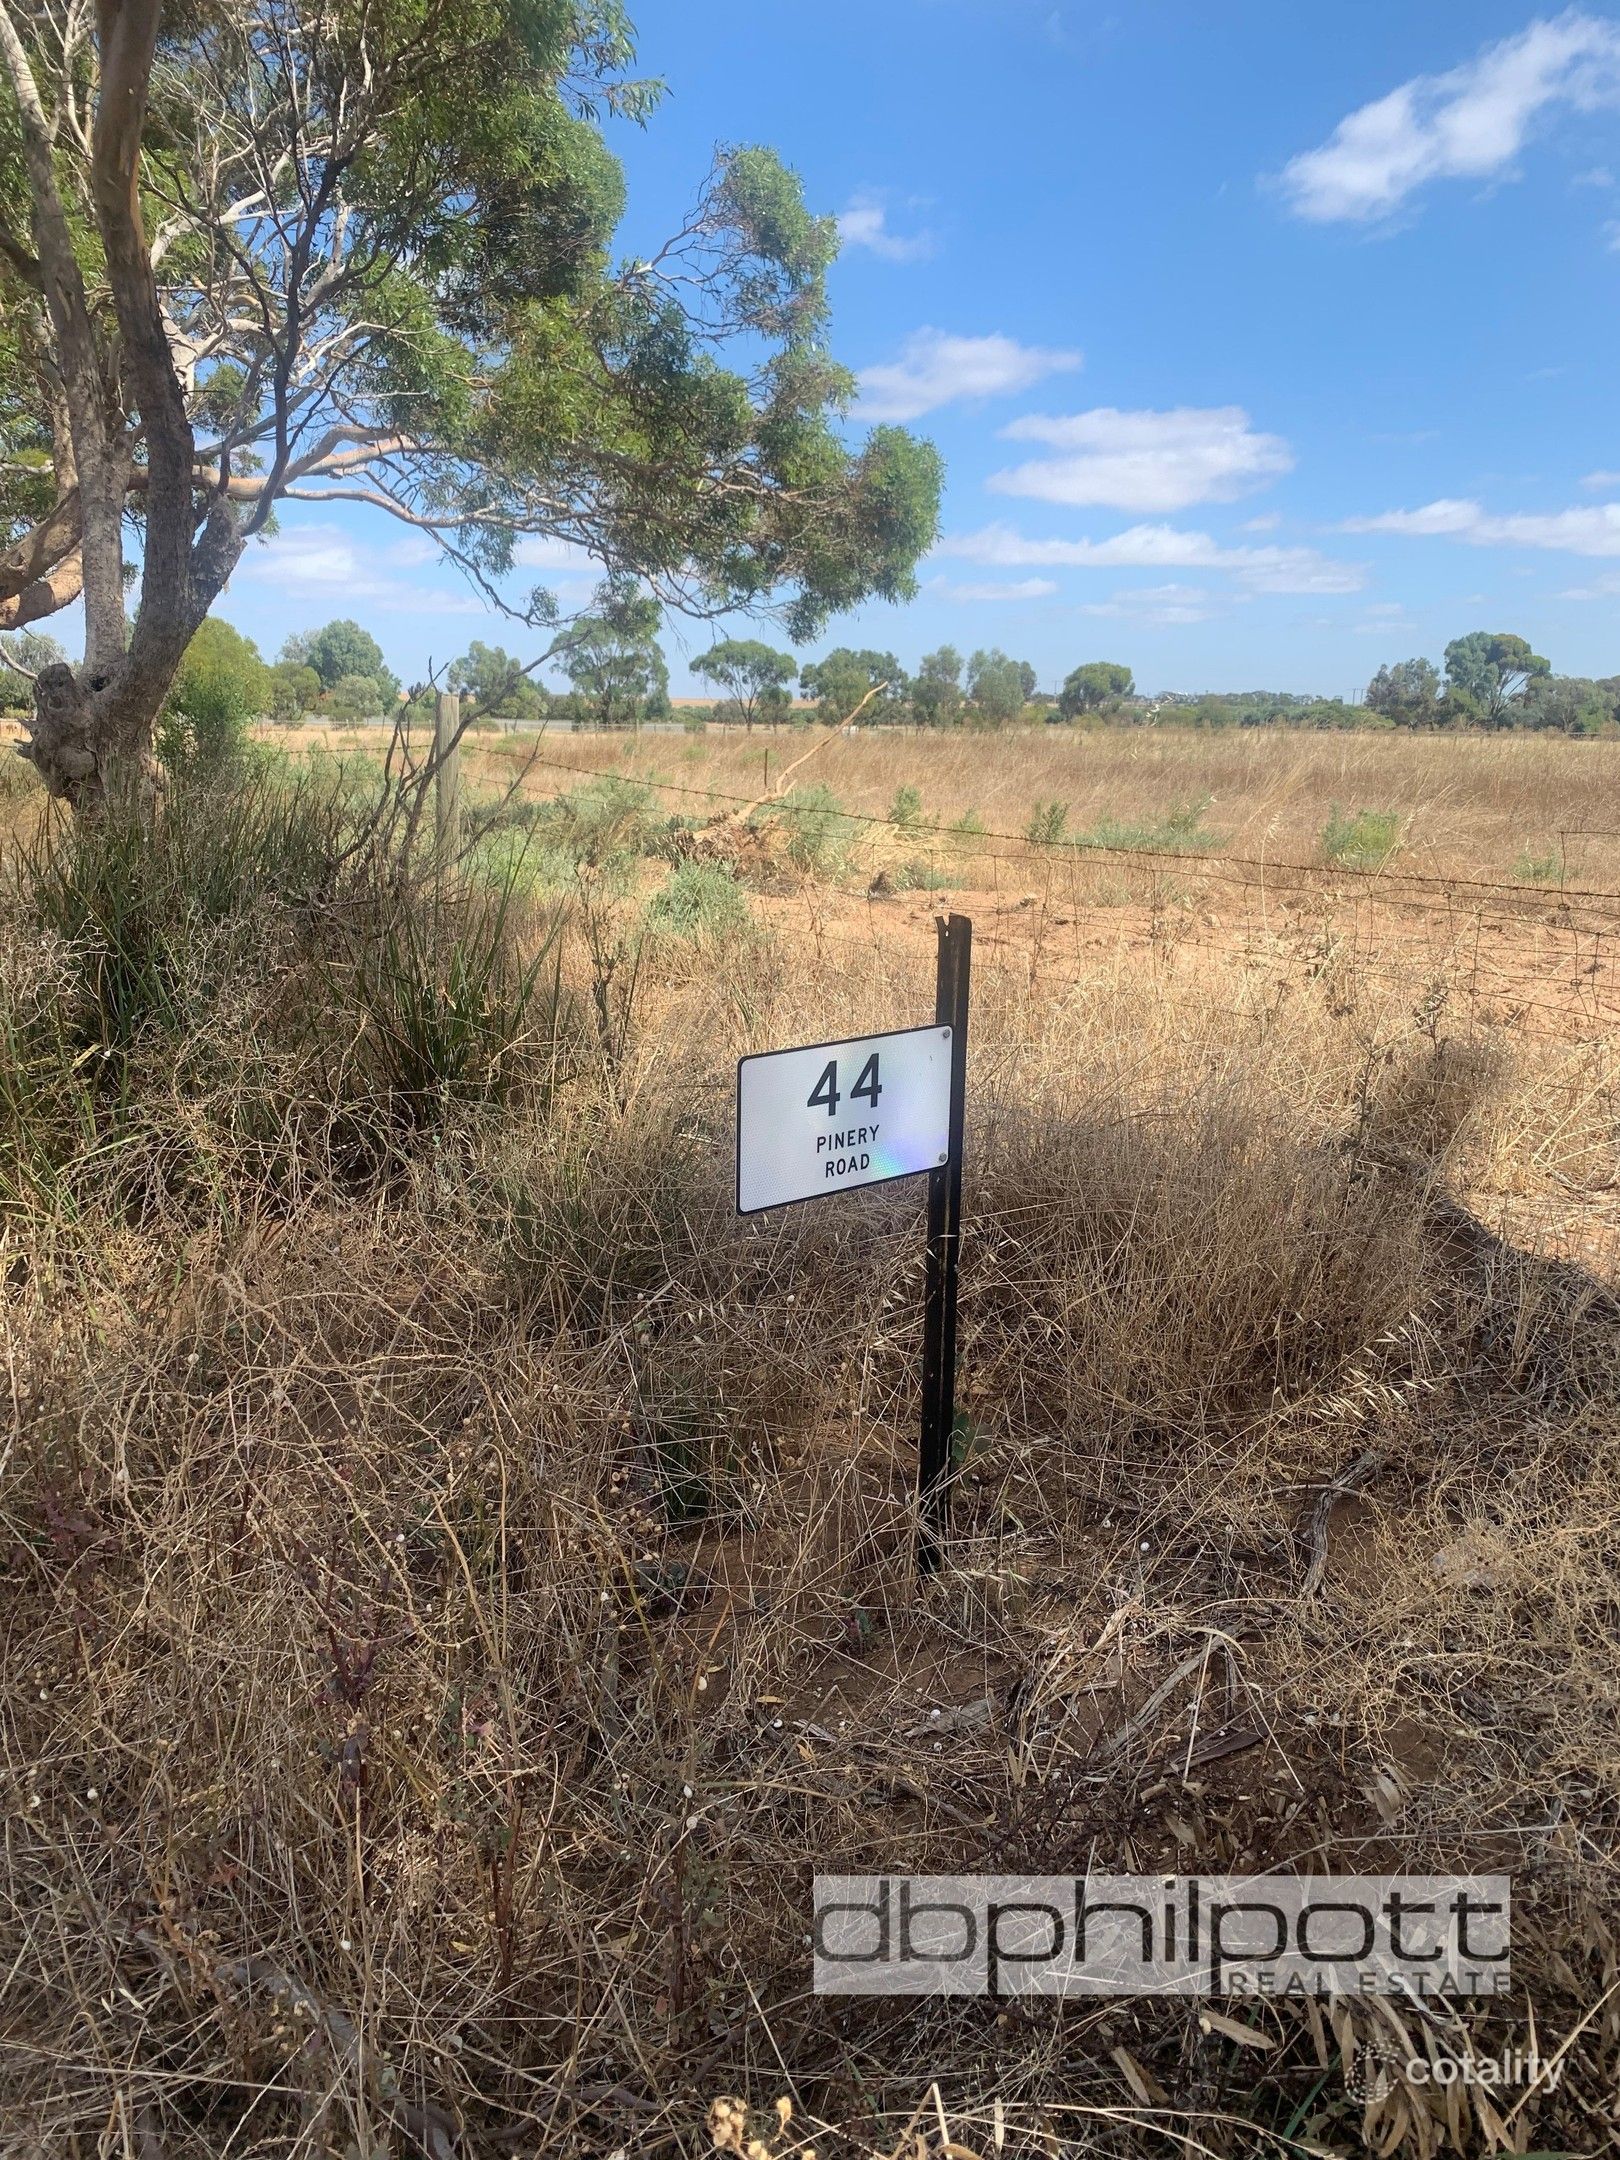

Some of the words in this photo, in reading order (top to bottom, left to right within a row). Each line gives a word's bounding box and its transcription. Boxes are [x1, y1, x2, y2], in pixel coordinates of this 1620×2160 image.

[807, 1053, 882, 1116] 44
[816, 1124, 880, 1153] PINERY
[825, 1153, 870, 1178] ROAD
